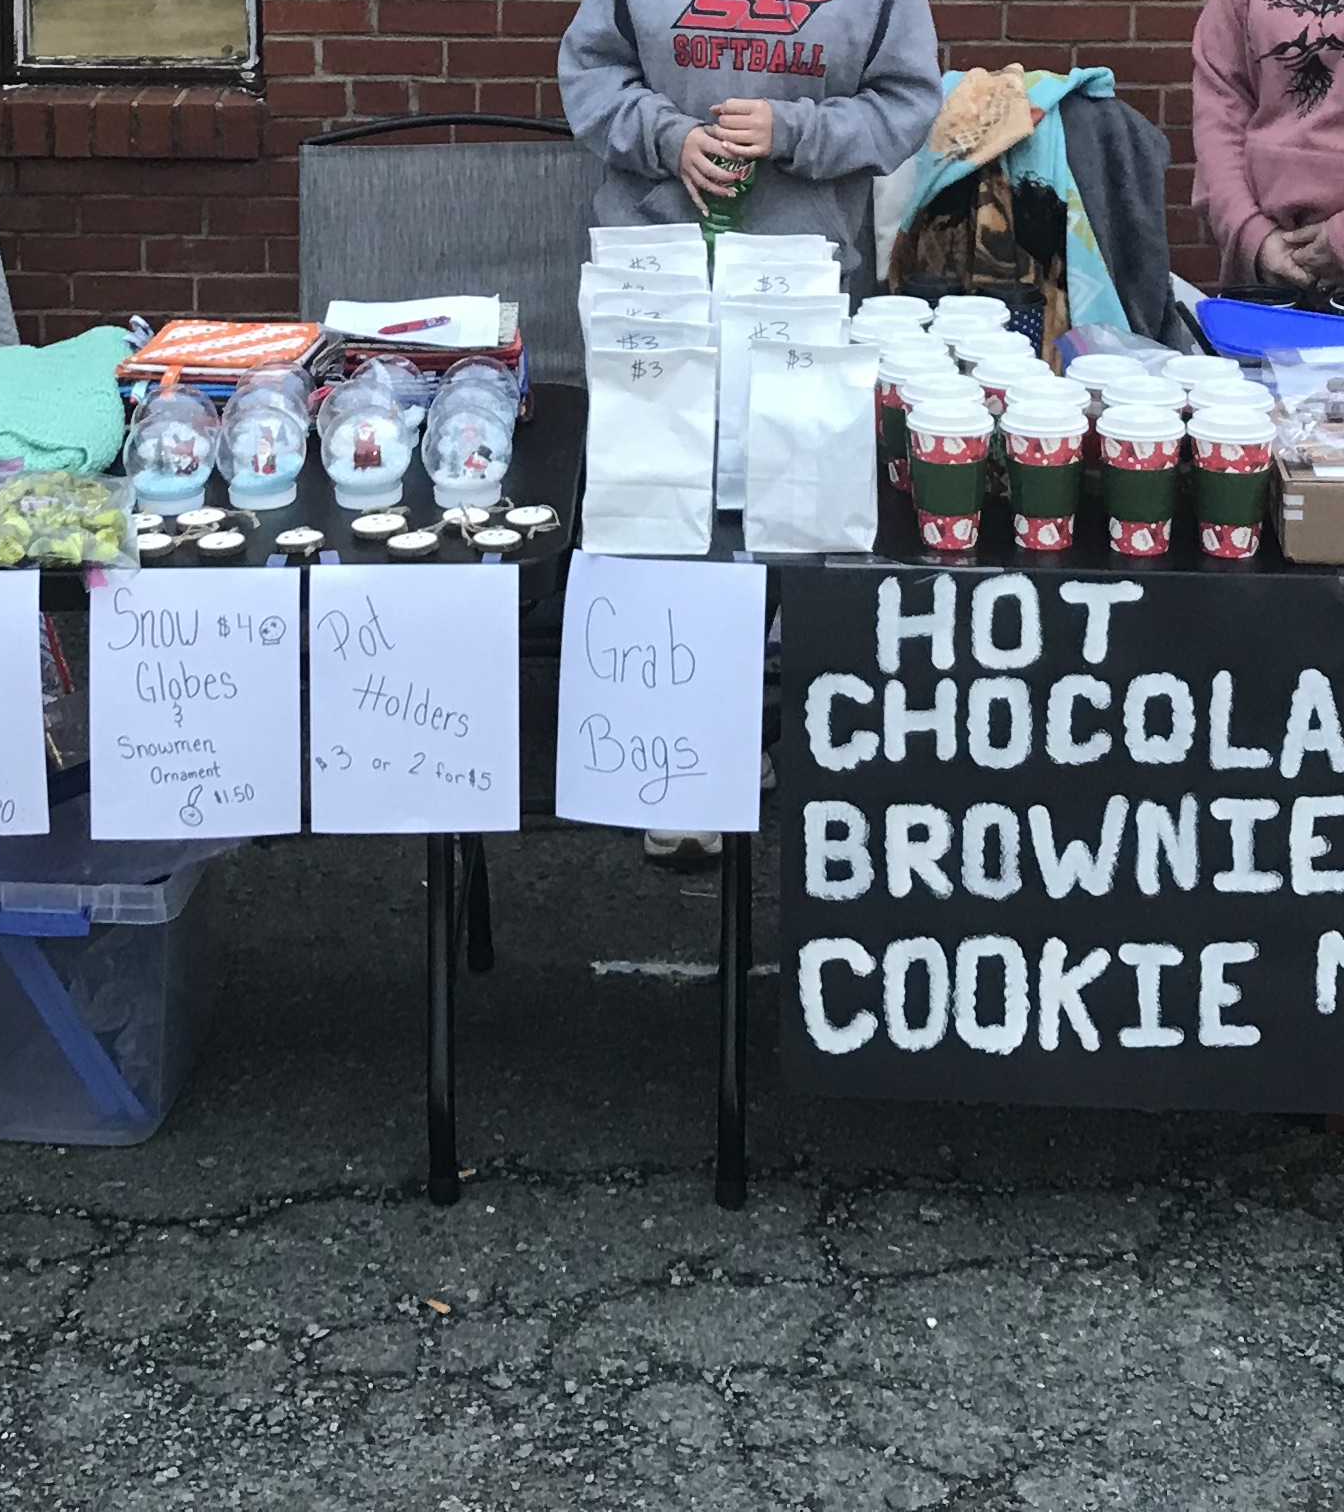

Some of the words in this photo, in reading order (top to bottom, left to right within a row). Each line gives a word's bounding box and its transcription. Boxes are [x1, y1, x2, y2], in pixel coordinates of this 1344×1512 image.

[673, 34, 826, 77] SOFTBALL
[754, 274, 790, 294] $3
[631, 358, 663, 382] $3
[786, 348, 814, 371] $3
[107, 587, 199, 651] Snow
[216, 613, 253, 643] $4
[317, 595, 396, 661] Pot
[877, 572, 1144, 673] HOT
[586, 596, 696, 689] Grab
[136, 661, 238, 704] Globes
[353, 673, 469, 738] Holders
[117, 735, 217, 759] Snowmen
[372, 758, 391, 771] or
[409, 752, 426, 775] 2
[579, 713, 708, 805] Bags
[150, 761, 222, 784] Ornament
[798, 934, 1261, 1055] COOKIE
